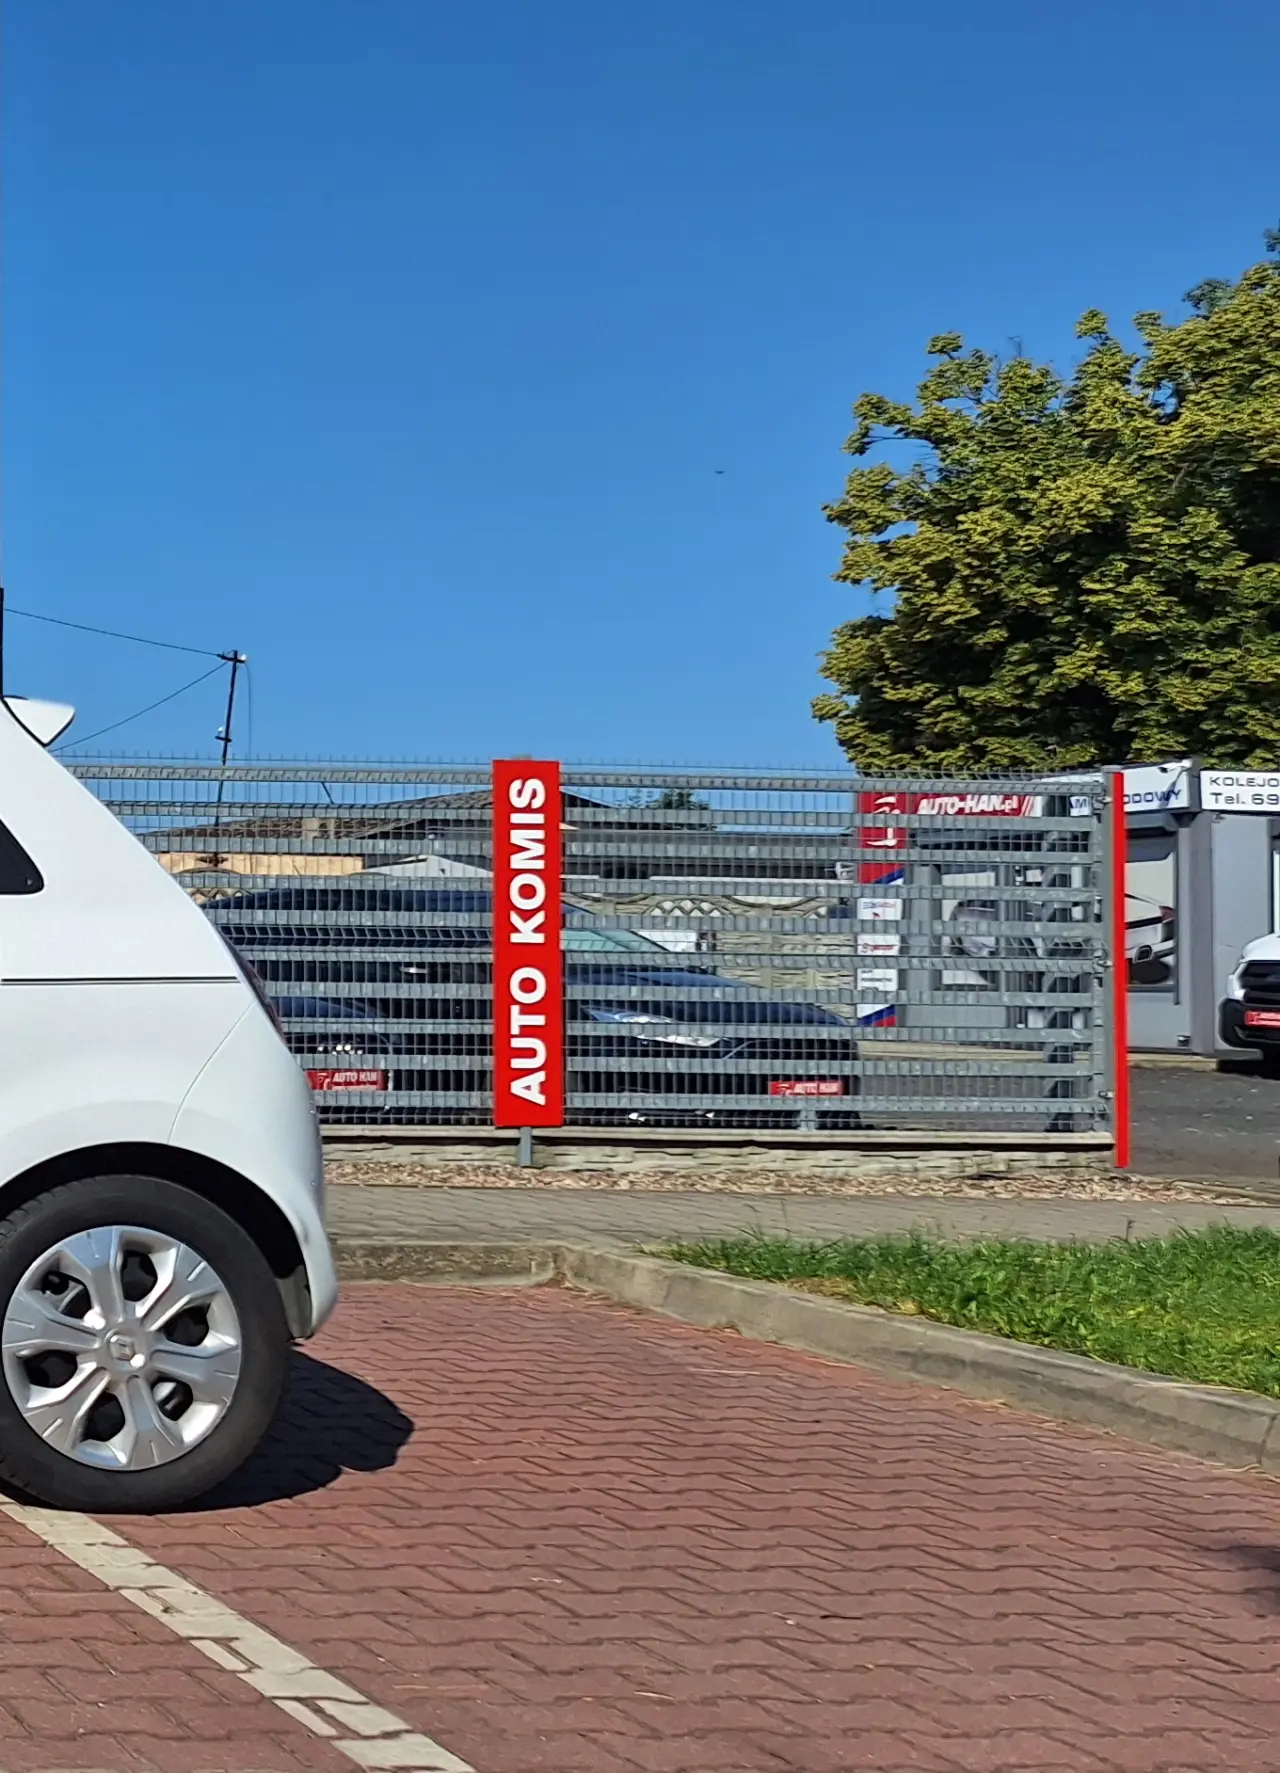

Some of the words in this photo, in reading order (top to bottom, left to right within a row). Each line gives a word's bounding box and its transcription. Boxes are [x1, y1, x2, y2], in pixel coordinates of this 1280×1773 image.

[508, 778, 546, 944] KOMIS
[1211, 792, 1245, 805] Tel.
[509, 966, 547, 1106] AUTO
